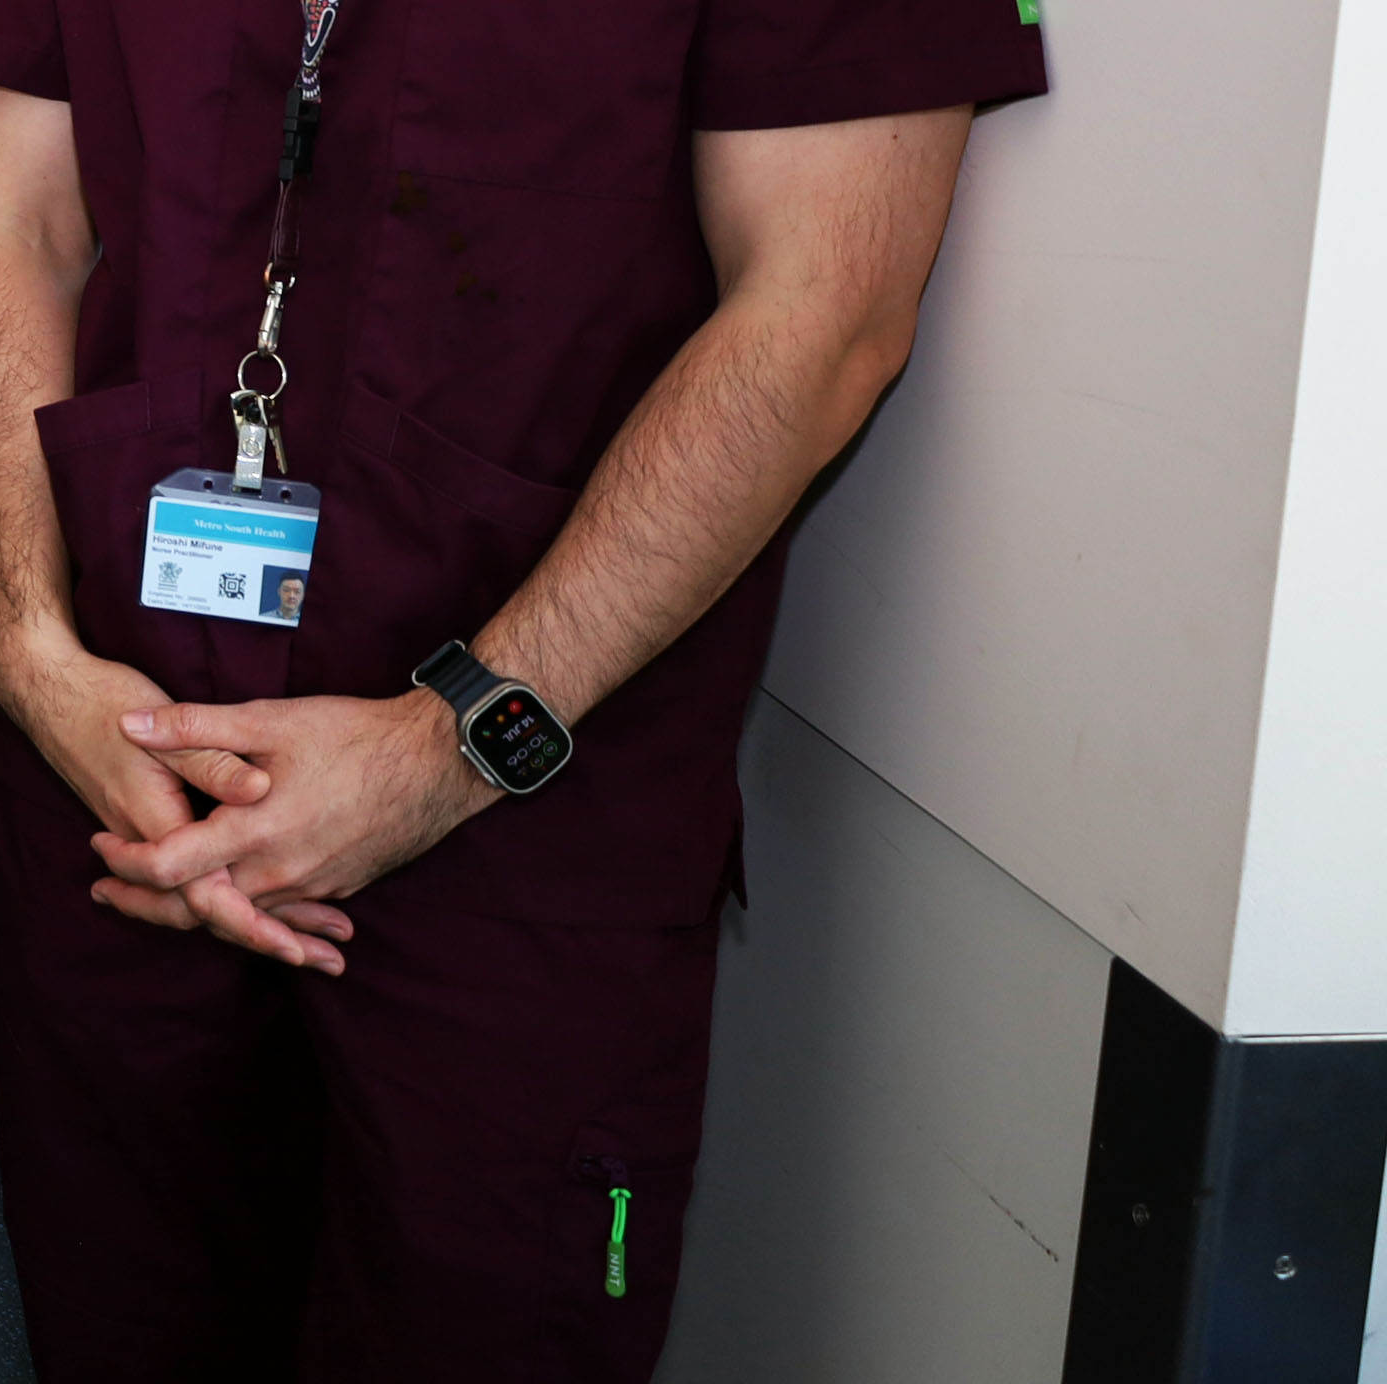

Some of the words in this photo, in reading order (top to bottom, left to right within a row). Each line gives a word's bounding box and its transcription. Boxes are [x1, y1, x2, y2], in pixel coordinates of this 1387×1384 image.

[194, 519, 223, 531] Metro
[224, 523, 252, 534] South
[254, 527, 286, 539] Health
[152, 535, 188, 547] Hiroshi
[190, 539, 224, 552] Mifune
[520, 714, 535, 729] 14
[502, 722, 522, 743] JUL
[609, 1252, 621, 1287] NNT
